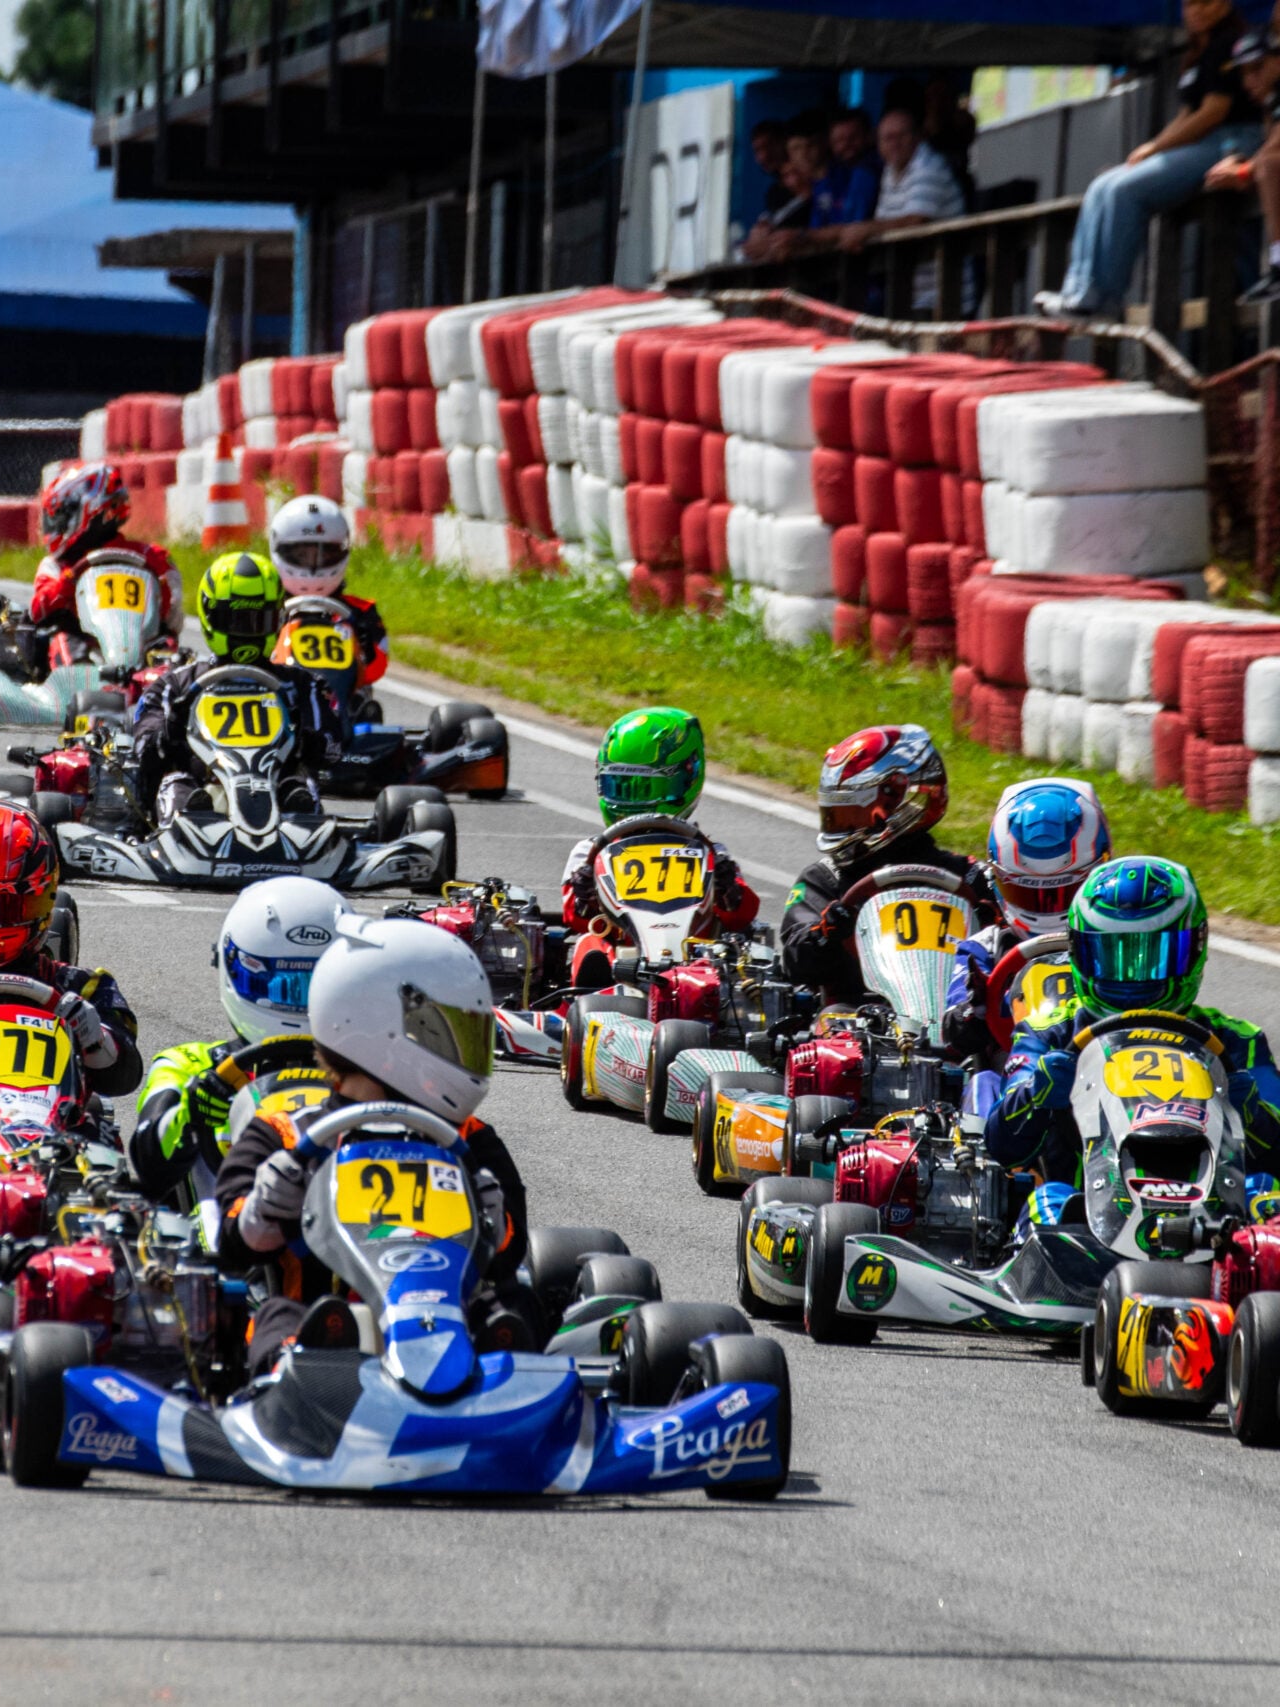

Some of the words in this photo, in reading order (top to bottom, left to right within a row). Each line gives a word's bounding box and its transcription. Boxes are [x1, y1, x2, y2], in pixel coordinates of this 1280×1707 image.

[104, 578, 141, 607] 19
[300, 633, 346, 663] 36
[212, 700, 271, 739] 20
[624, 857, 696, 896] 277
[287, 926, 327, 941] Arai
[895, 902, 951, 948] 07
[275, 959, 313, 970] Bruno
[20, 1016, 42, 1028] F4
[1127, 1028, 1185, 1043] Mini
[277, 1067, 327, 1082] Min
[1132, 1050, 1184, 1082] 21
[433, 1166, 459, 1181] F4
[437, 1181, 458, 1192] G
[360, 1163, 429, 1225] 27
[857, 1265, 884, 1285] M
[67, 1412, 137, 1462] Praga
[626, 1414, 771, 1480] Praga
